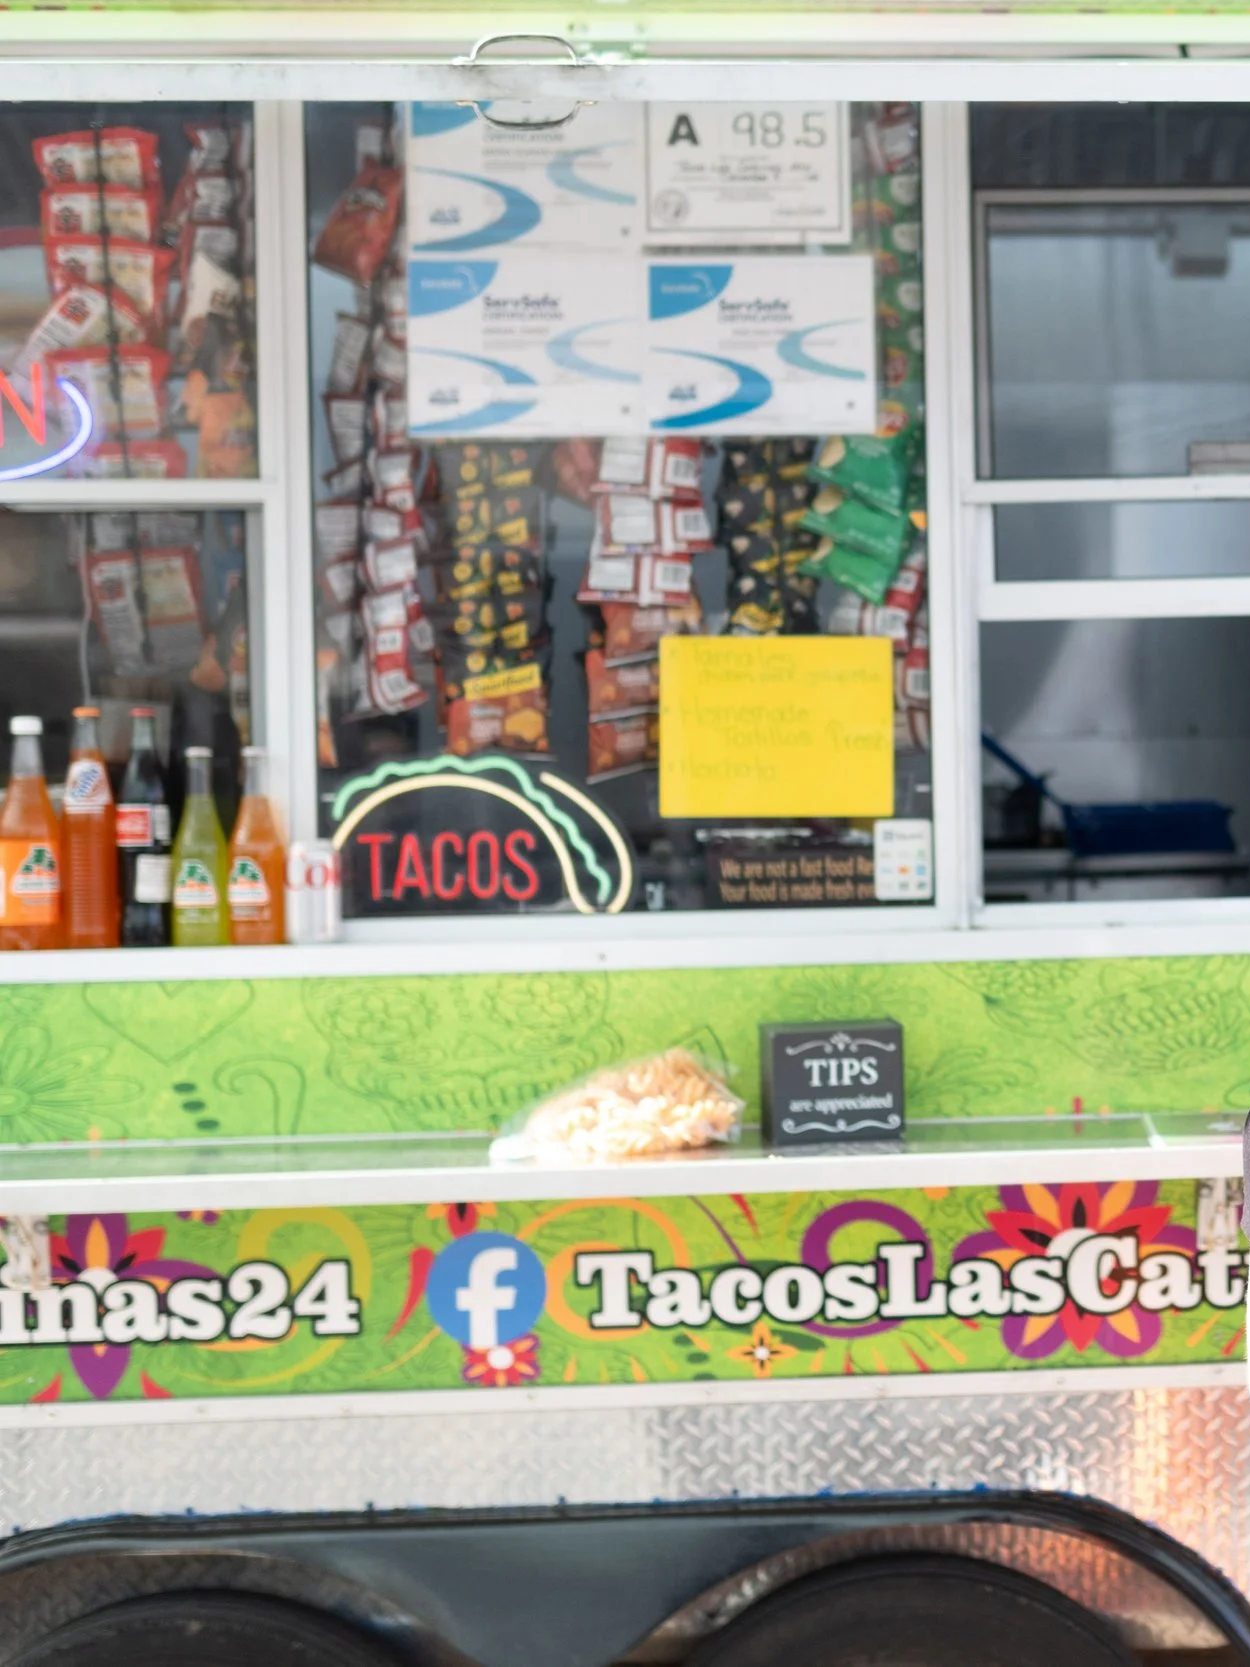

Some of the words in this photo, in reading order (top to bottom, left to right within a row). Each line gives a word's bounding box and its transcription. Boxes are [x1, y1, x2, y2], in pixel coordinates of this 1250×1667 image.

[665, 111, 702, 148] A
[483, 292, 560, 310] ServSafe
[718, 296, 790, 314] ServSafe
[356, 829, 540, 901] TACOS
[719, 857, 741, 879] We
[743, 861, 764, 879] are
[766, 859, 787, 878] not
[800, 857, 823, 877] fast
[825, 855, 854, 877] food
[720, 880, 747, 902] Your
[749, 879, 776, 902] food
[790, 880, 824, 901] made
[826, 878, 854, 900] fresh
[802, 1056, 879, 1088] TIPS
[789, 1098, 813, 1113] are
[814, 1092, 894, 1115] appreciated
[576, 1236, 1249, 1328] TacosLasCat
